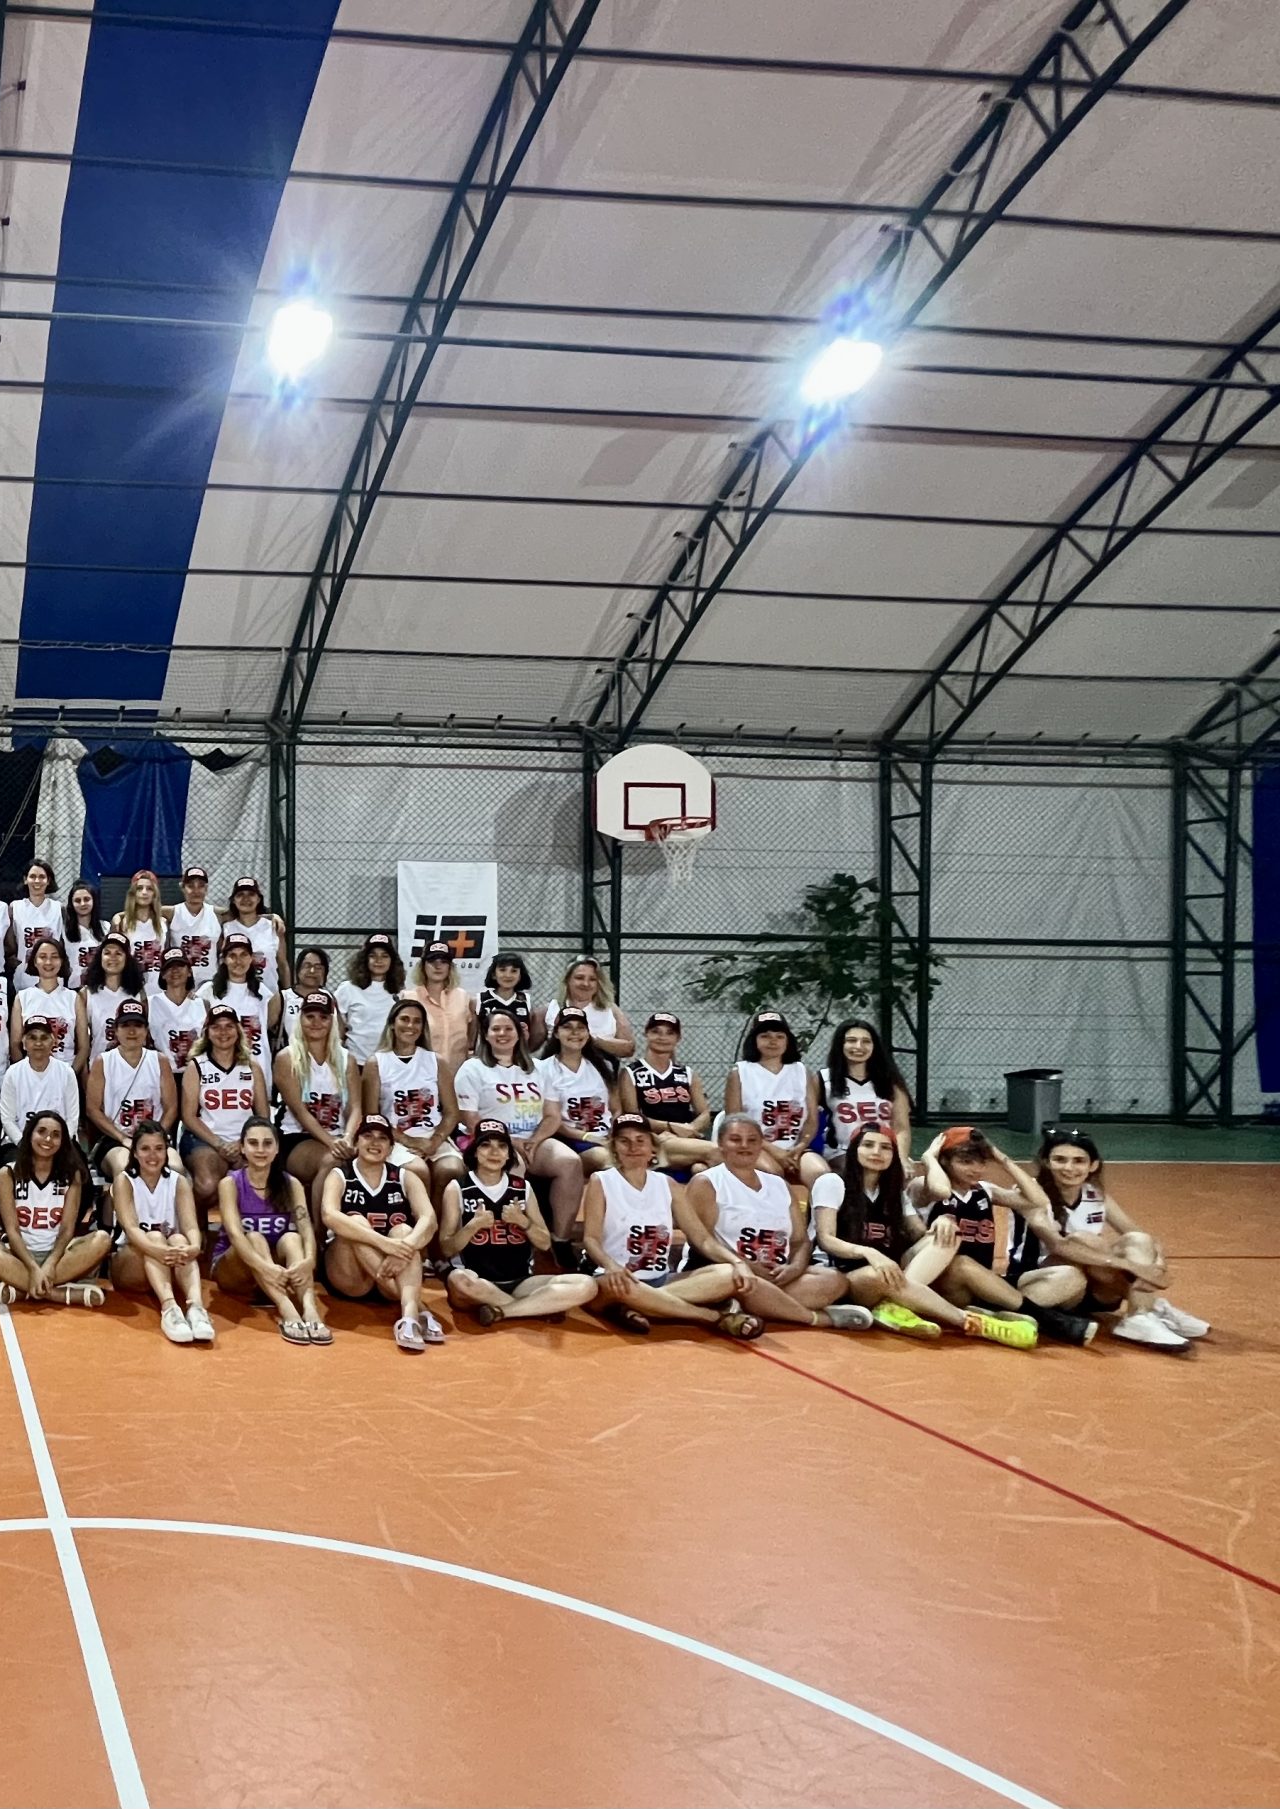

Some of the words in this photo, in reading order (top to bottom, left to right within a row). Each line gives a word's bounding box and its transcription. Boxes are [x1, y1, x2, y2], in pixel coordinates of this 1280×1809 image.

[122, 1003, 143, 1014] SES
[204, 1089, 253, 1110] SES
[496, 1083, 541, 1104] SES
[644, 1087, 691, 1105] SES
[836, 1101, 892, 1124] SES
[16, 1206, 64, 1230] SES
[242, 1217, 286, 1234] SES
[740, 1227, 788, 1245] SES
[958, 1219, 997, 1244] ES
